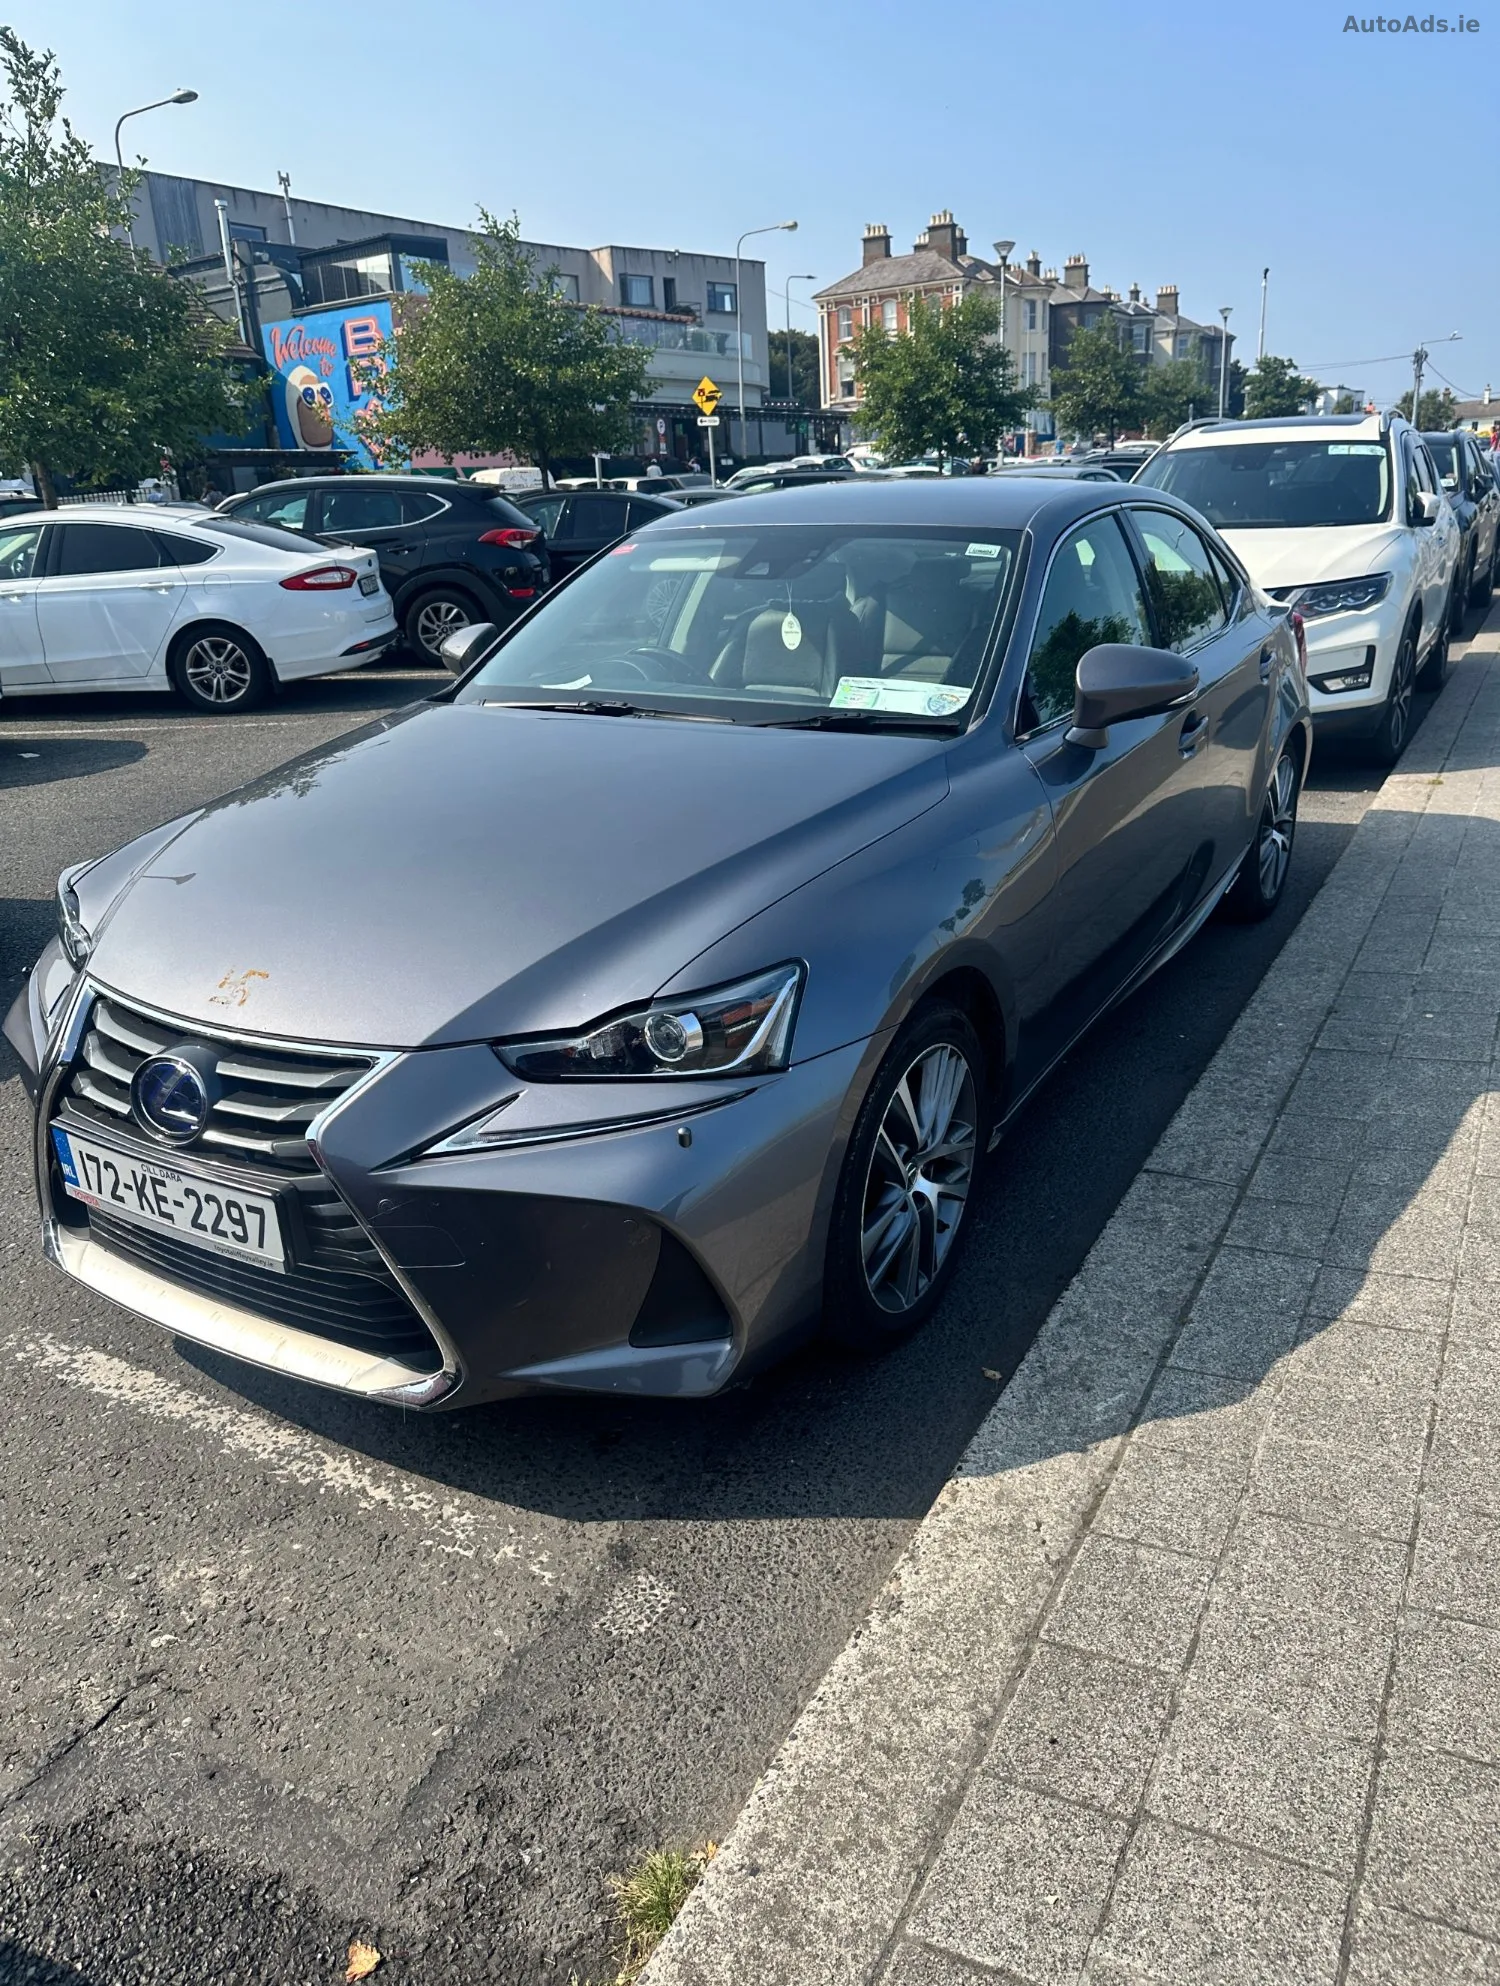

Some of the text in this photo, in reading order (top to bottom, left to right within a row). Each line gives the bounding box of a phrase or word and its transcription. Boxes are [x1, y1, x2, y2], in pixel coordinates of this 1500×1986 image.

[270, 325, 336, 371] Welcome
[319, 357, 334, 377] to
[61, 1161, 76, 1179] IRL
[141, 1163, 183, 1184] CILL DARA
[72, 1189, 100, 1208] TOYOTA
[79, 1149, 266, 1249] 172-KE-2297
